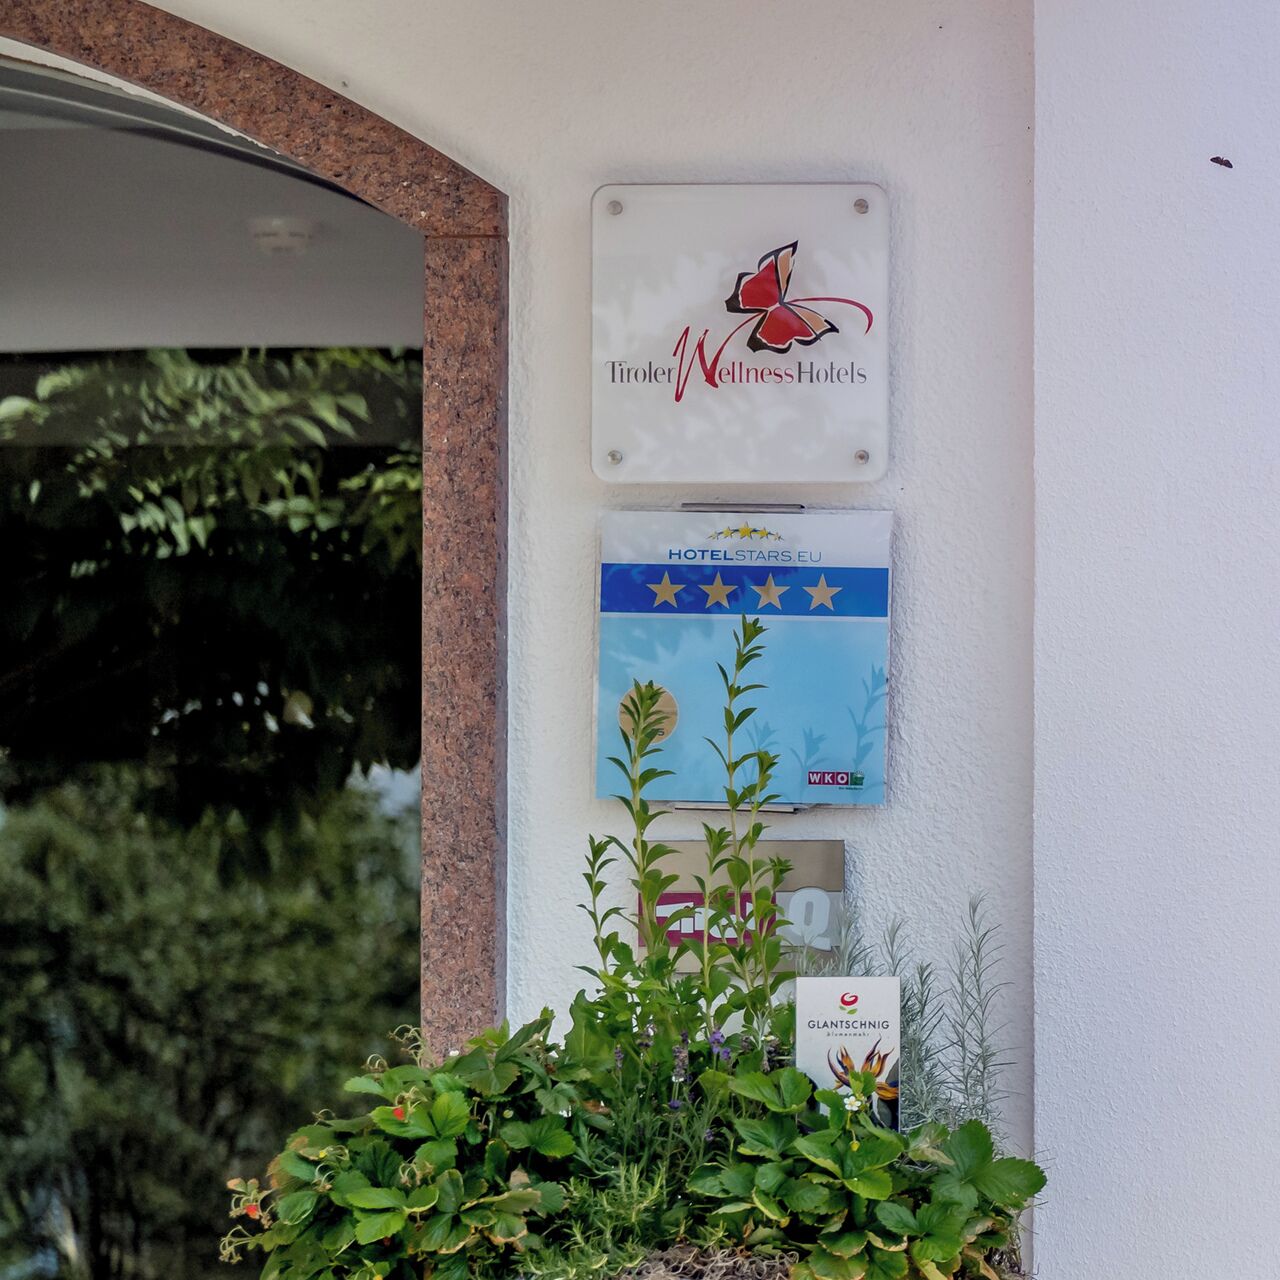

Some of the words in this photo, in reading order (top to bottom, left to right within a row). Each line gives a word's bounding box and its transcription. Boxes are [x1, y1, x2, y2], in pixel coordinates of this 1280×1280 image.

[668, 549, 822, 563] HOTELSTARS.EU
[809, 772, 848, 784] WKO
[807, 1019, 890, 1030] GLANTSCHNIG
